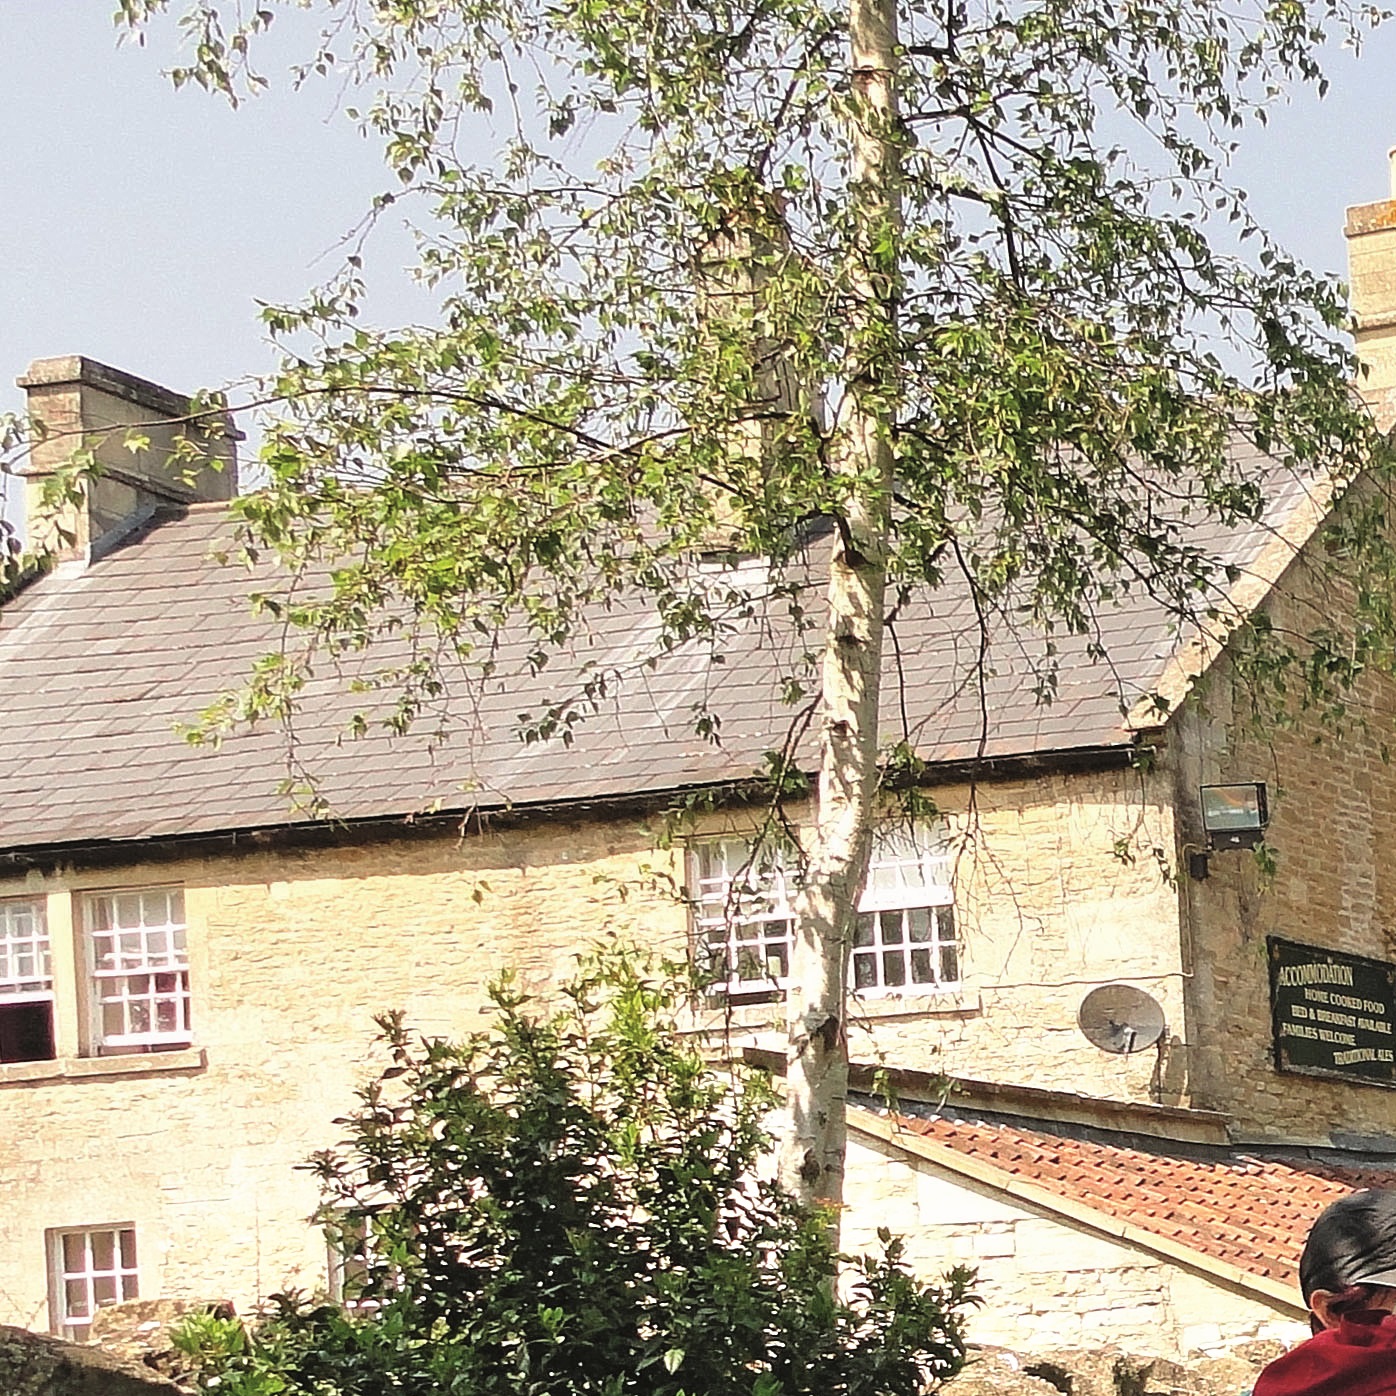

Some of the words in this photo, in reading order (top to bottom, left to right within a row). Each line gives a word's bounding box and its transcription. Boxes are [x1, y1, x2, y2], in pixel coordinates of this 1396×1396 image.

[1279, 963, 1354, 987] ACCOMMODATION
[1304, 987, 1329, 1004] HOME
[1329, 992, 1362, 1010] COOKED
[1363, 999, 1385, 1014] FOOD
[1291, 1004, 1308, 1018] BED
[1308, 1007, 1316, 1020] &
[1316, 1009, 1356, 1027] BREAKFAST
[1358, 1018, 1392, 1034] AVAILABLE
[1282, 1022, 1318, 1039] FAMILIES
[1318, 1028, 1357, 1046] WELCOME
[1333, 1048, 1376, 1065] TRADITIONAL
[1377, 1048, 1394, 1062] ALES
